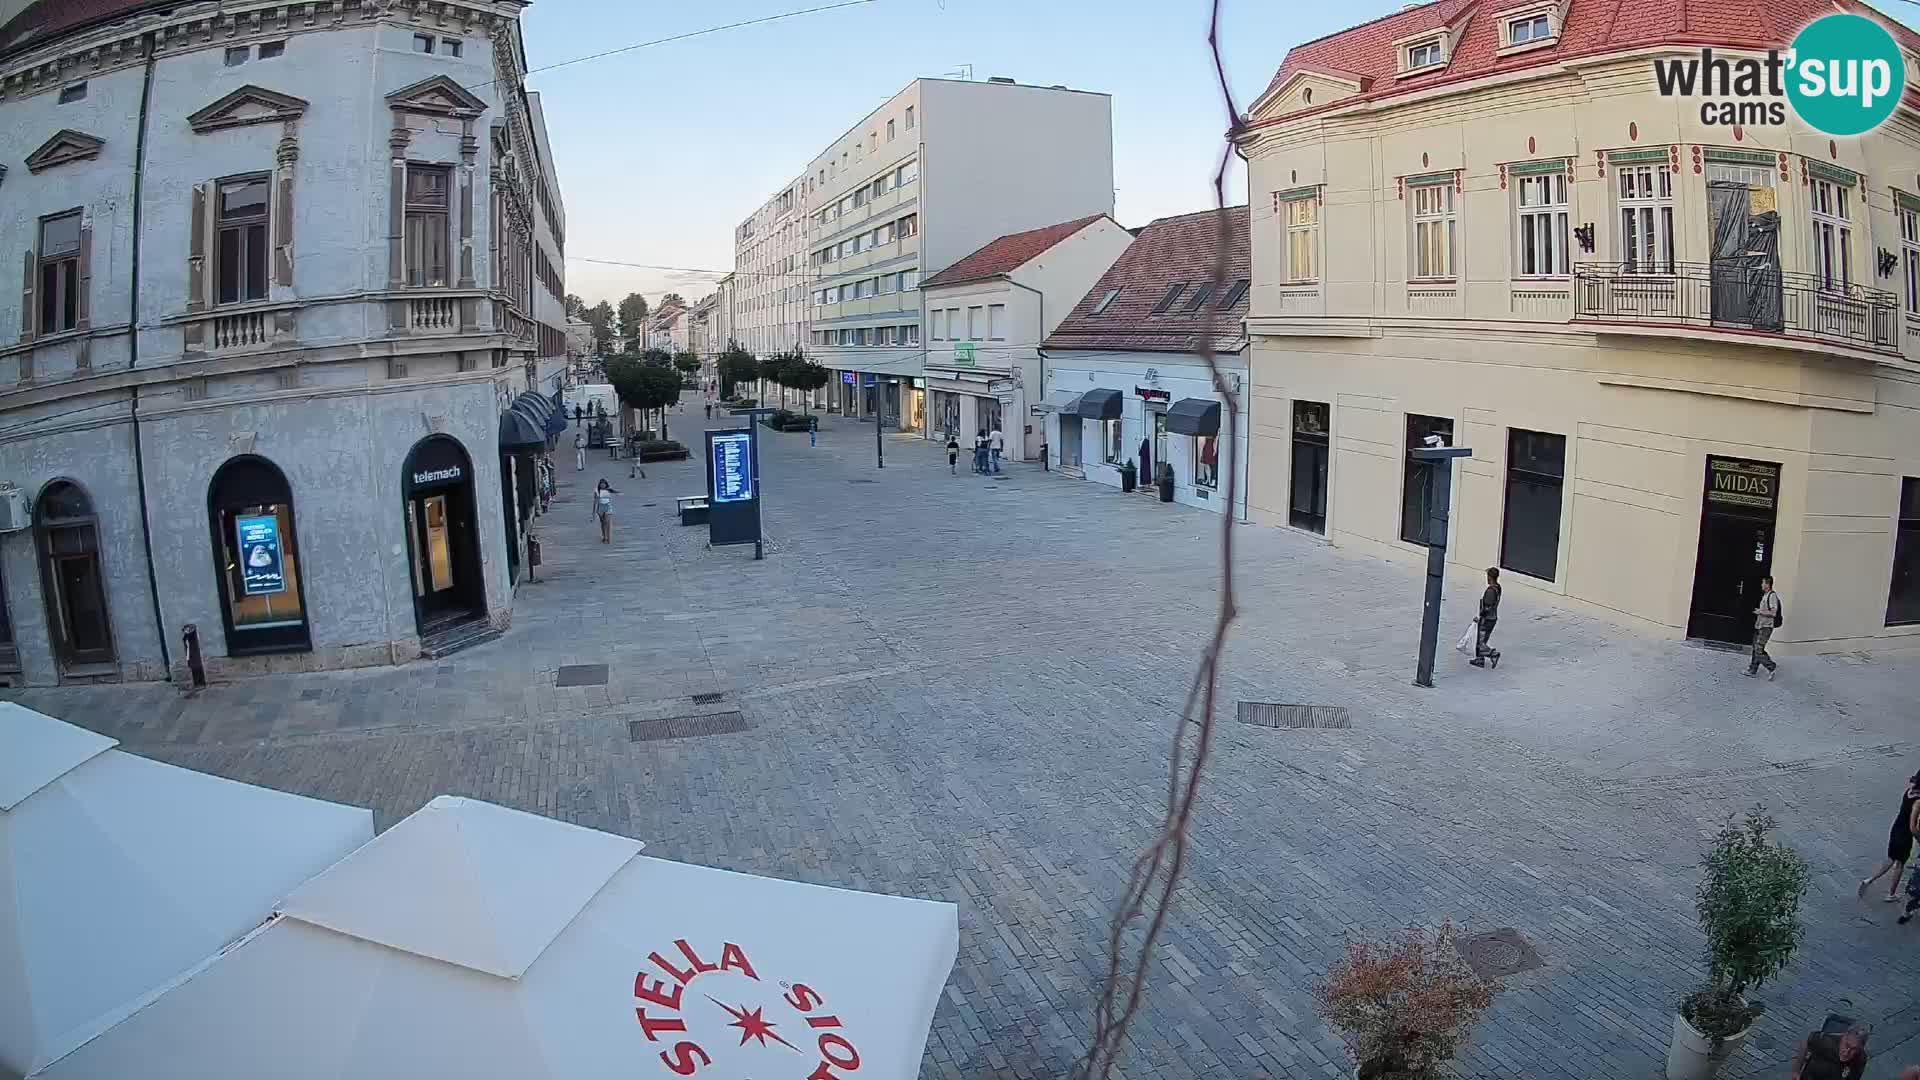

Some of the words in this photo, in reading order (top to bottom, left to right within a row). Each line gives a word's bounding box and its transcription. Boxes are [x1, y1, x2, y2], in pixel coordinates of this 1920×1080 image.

[414, 465, 461, 484] telemach
[1714, 472, 1769, 495] MIDAS
[634, 938, 761, 1076] STELLA
